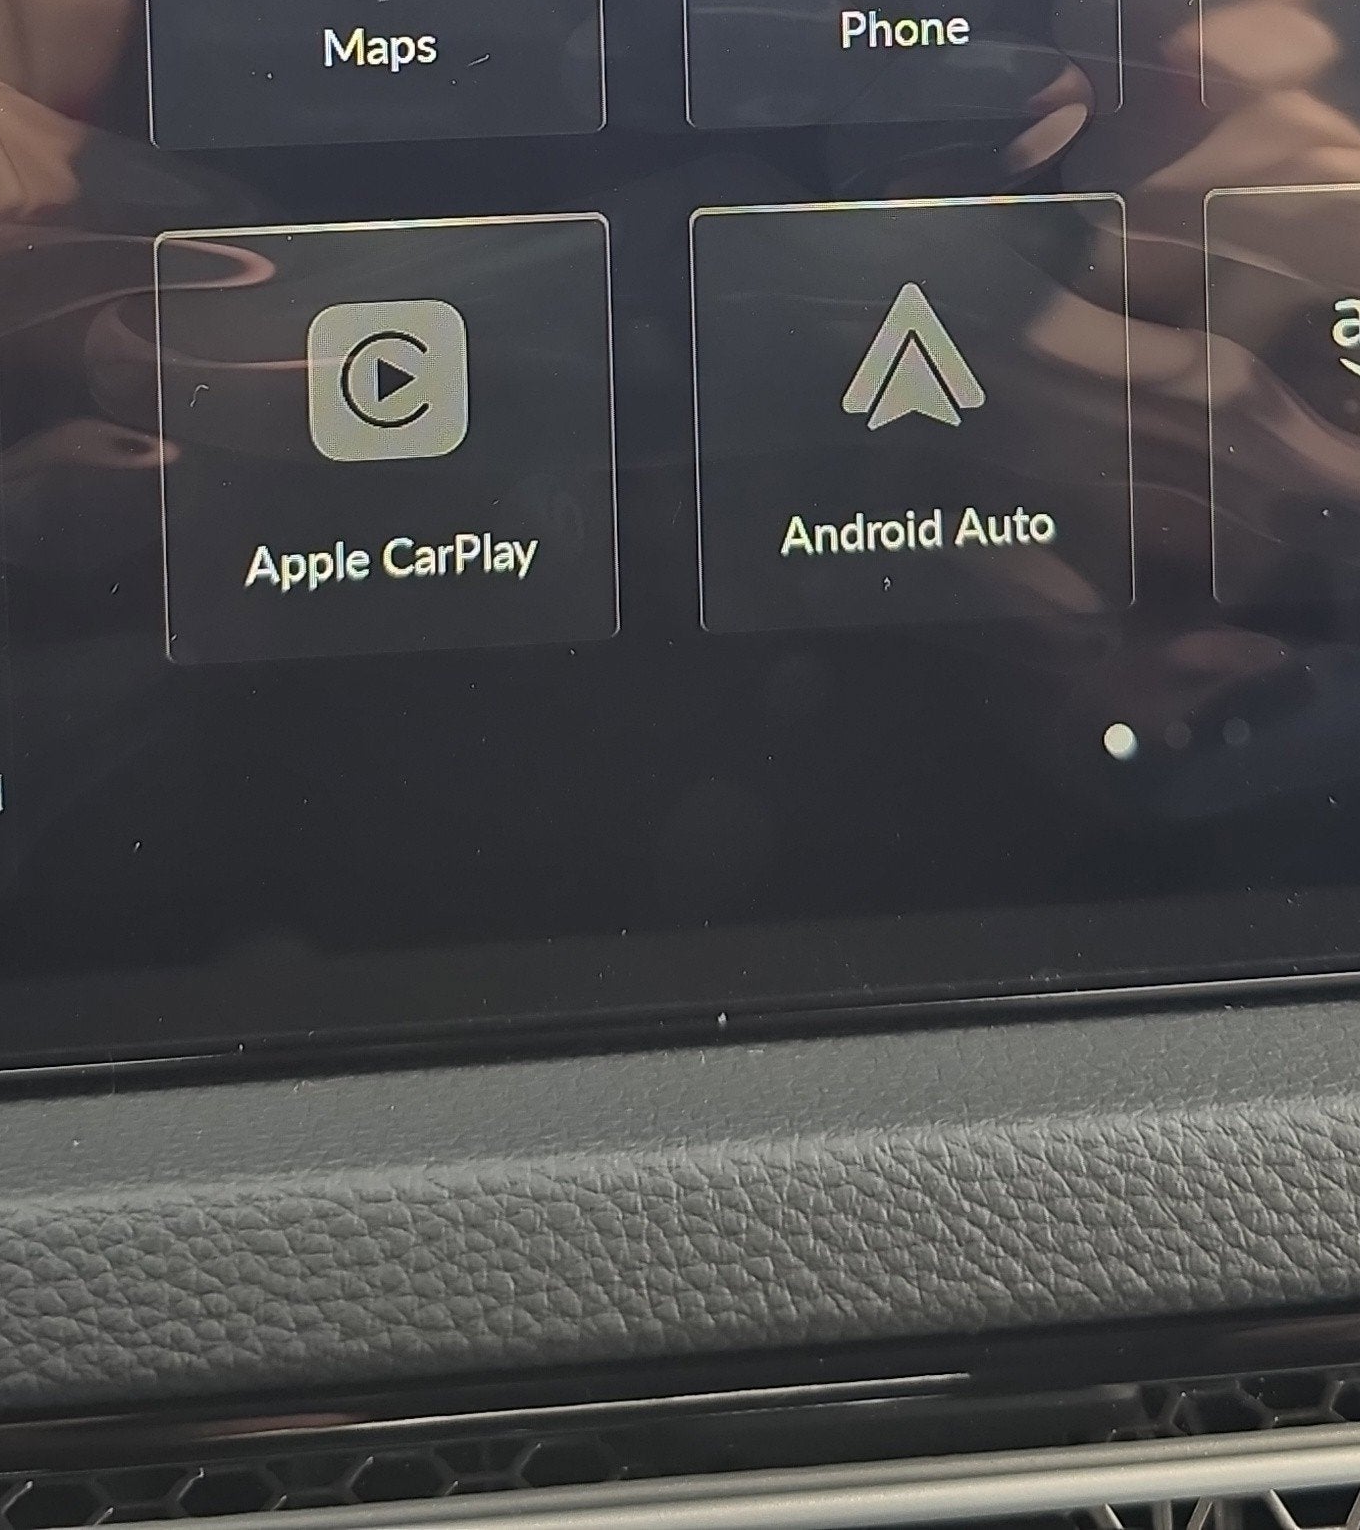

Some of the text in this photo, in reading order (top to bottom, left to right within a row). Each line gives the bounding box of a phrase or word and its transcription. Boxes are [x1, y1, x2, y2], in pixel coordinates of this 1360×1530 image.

[322, 27, 438, 73] Maps
[841, 9, 972, 49] Phone
[780, 504, 1057, 557] Android Auto
[243, 531, 539, 593] Apple CarPlay
